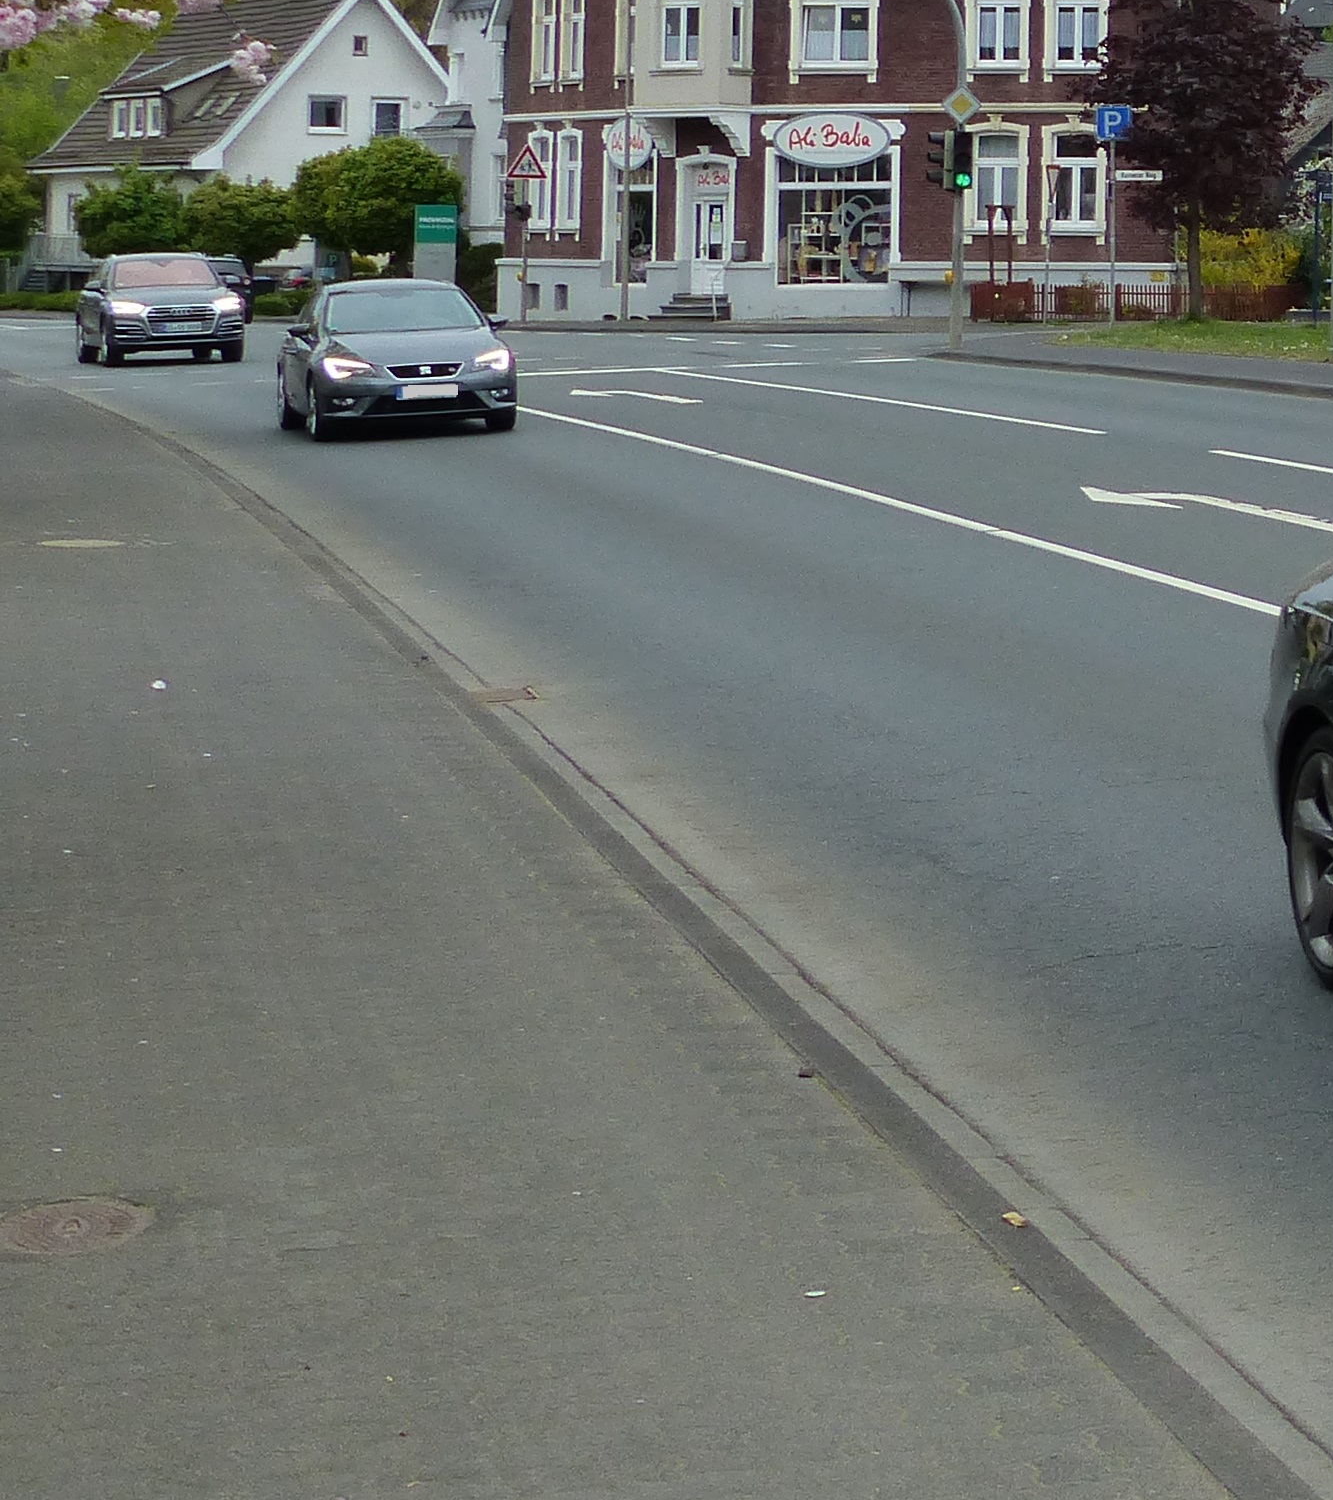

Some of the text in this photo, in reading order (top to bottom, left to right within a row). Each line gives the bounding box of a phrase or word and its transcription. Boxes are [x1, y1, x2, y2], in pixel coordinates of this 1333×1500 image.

[788, 121, 871, 150] Ali Baba
[1105, 111, 1122, 137] P
